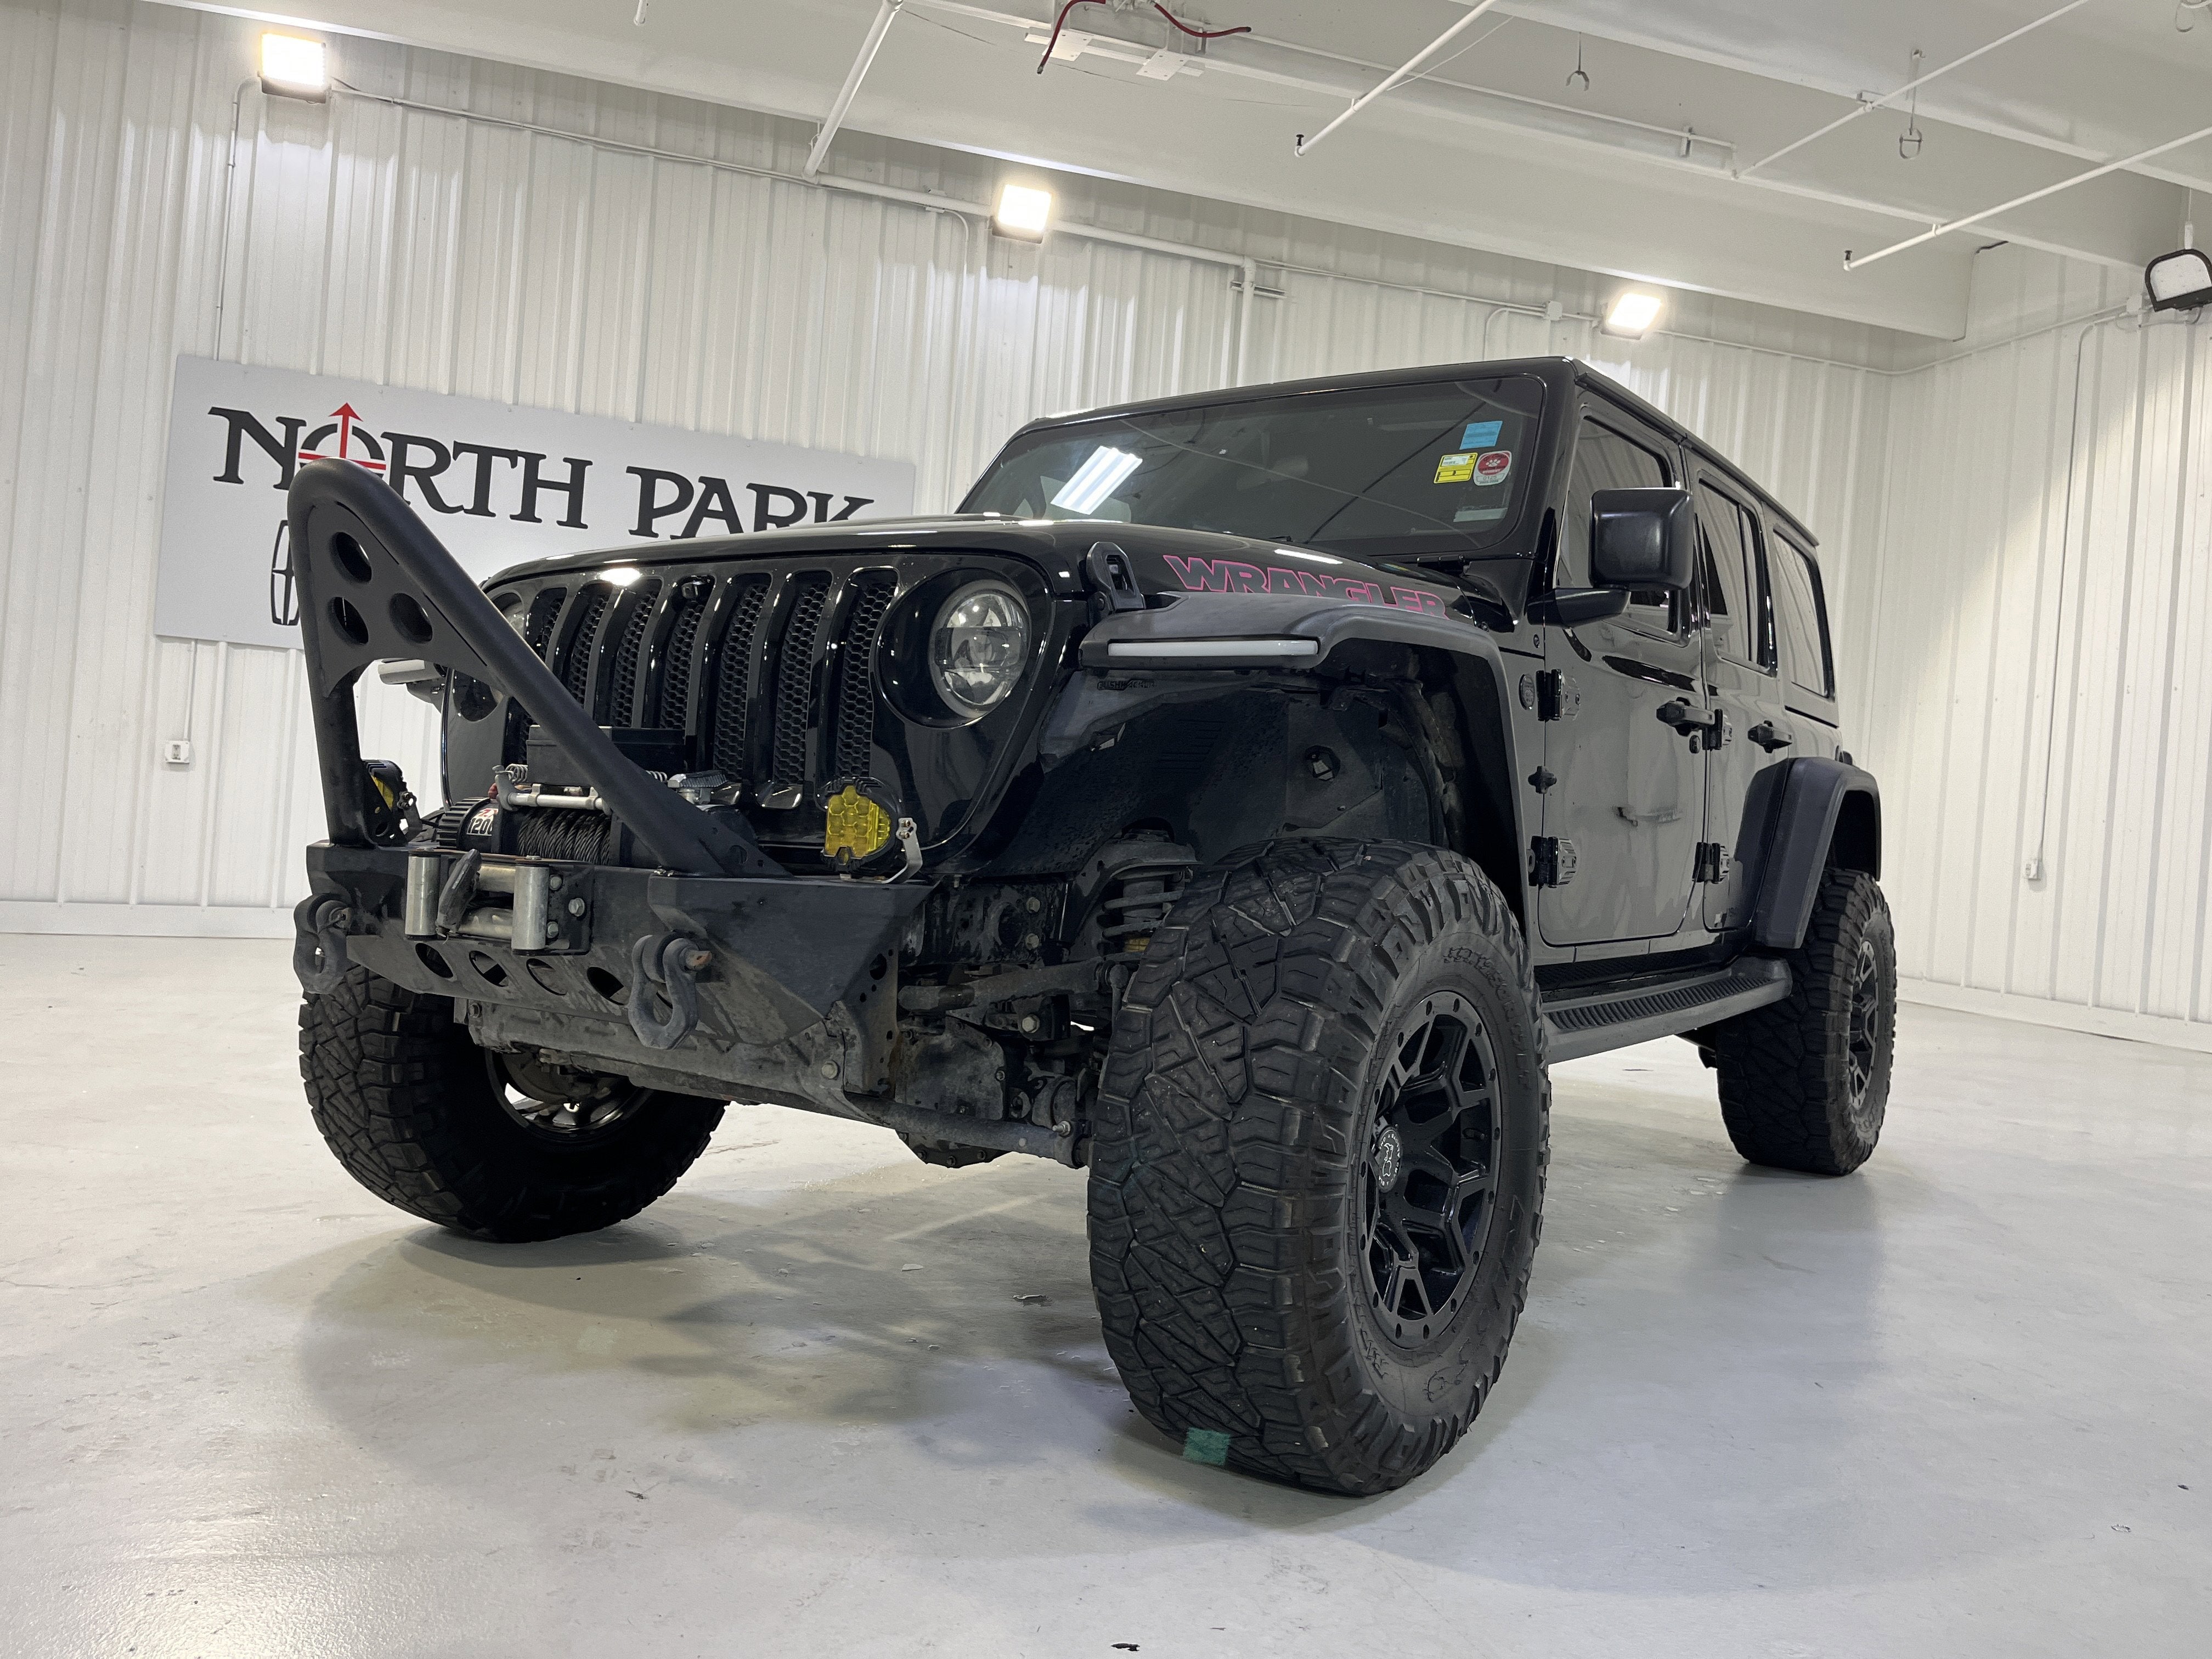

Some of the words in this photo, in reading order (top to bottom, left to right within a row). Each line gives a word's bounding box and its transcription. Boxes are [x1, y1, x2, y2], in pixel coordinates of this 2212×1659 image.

[207, 406, 593, 529] NORTH
[625, 466, 874, 540] PARK
[1163, 555, 1449, 620] WRANGLER
